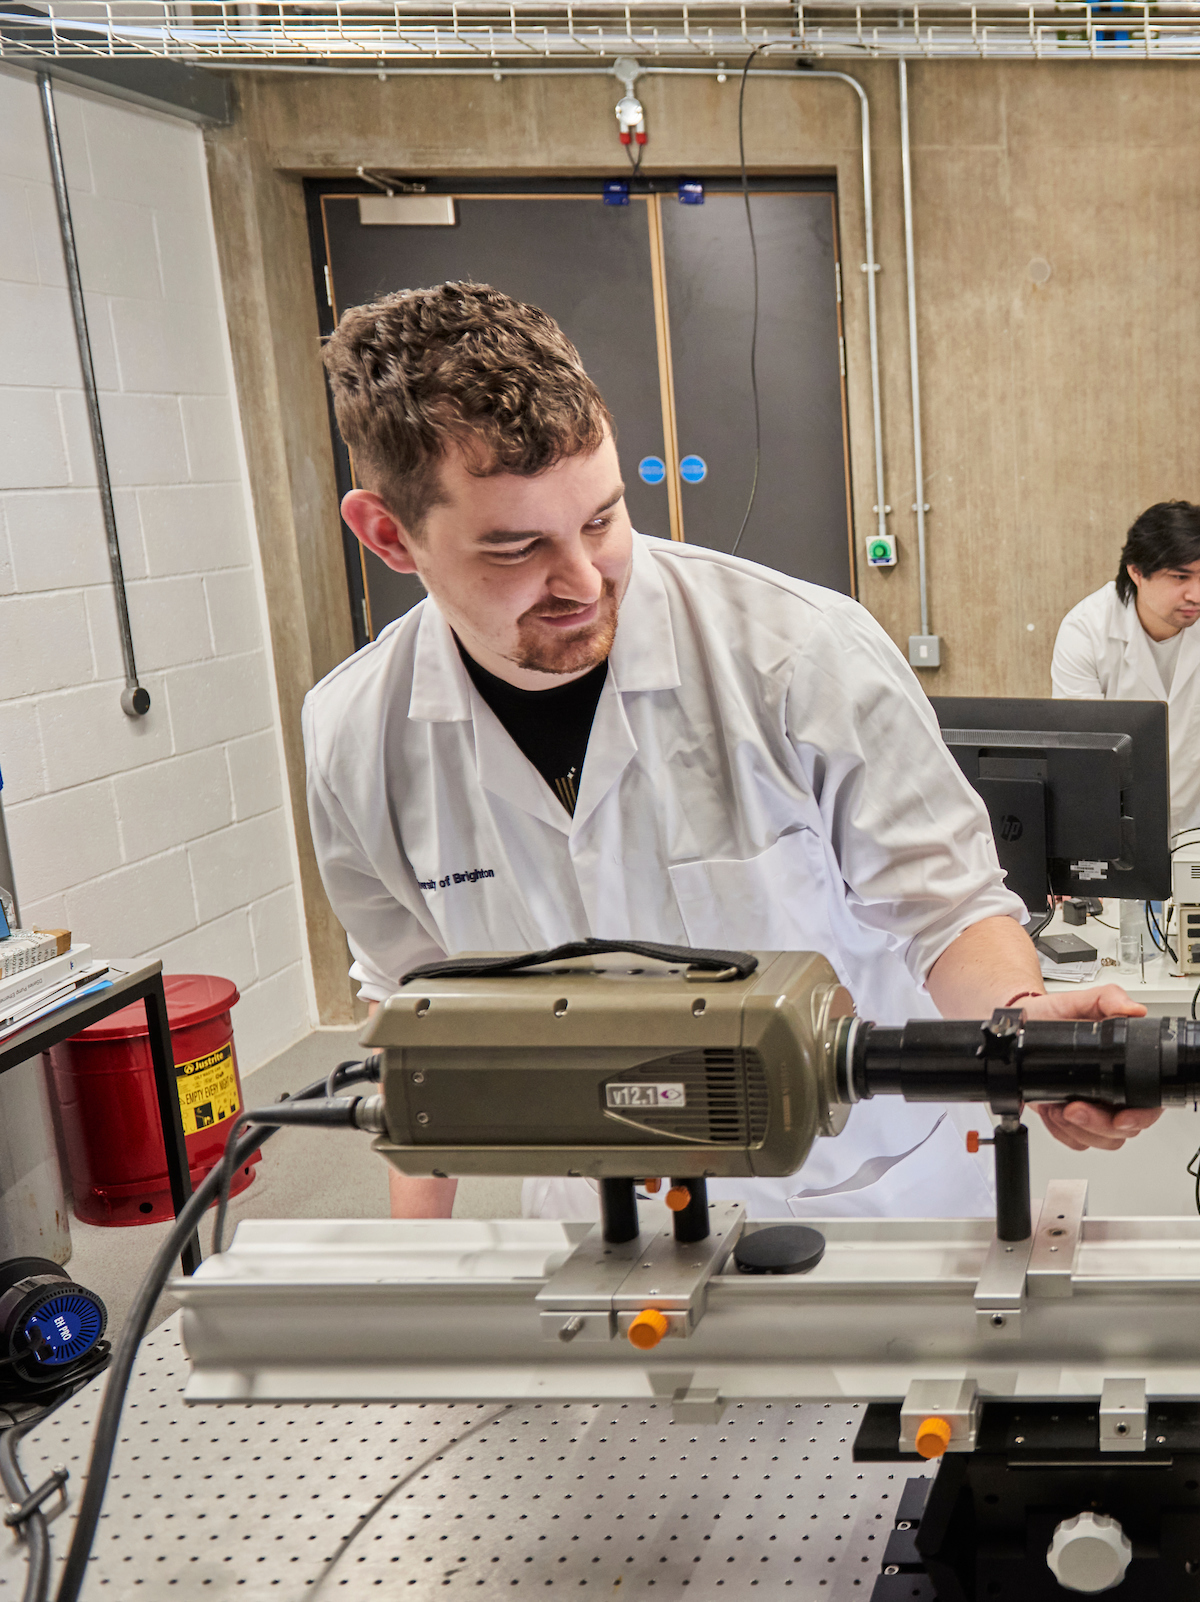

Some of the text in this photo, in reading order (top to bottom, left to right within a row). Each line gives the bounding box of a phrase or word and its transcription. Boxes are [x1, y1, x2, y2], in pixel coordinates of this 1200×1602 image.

[1001, 815, 1021, 842] hp
[439, 875, 450, 888] of
[452, 868, 495, 883] Brighton
[195, 1052, 224, 1071] Justrite
[185, 1089, 204, 1105] EMPTY
[205, 1082, 219, 1098] EVERY
[613, 1087, 654, 1105] v12.1
[53, 1316, 73, 1341] EH PRO
